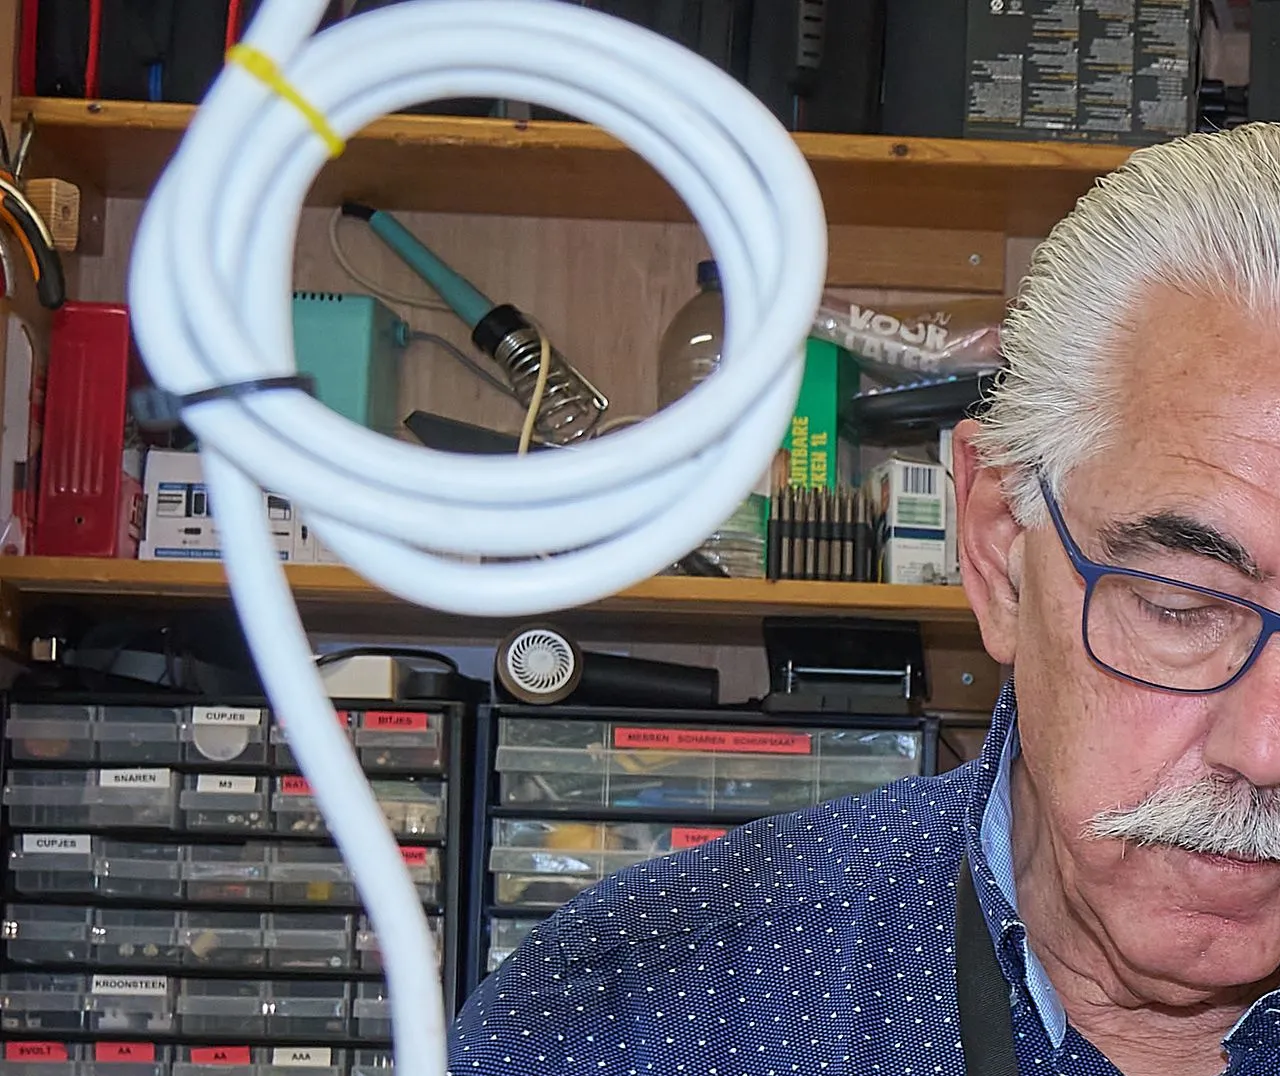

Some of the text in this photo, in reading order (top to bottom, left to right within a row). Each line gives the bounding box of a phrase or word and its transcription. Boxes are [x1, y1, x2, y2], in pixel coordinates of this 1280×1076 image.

[791, 416, 809, 488] UITBARE
[206, 711, 245, 721] CUPJES
[114, 774, 156, 783] SNAREN
[219, 781, 233, 789] M3
[36, 839, 77, 848] CUPJES
[95, 979, 166, 989] KROONSTEEN
[117, 1046, 131, 1055] AA
[213, 1052, 227, 1061] AA
[291, 1052, 311, 1061] AAA
